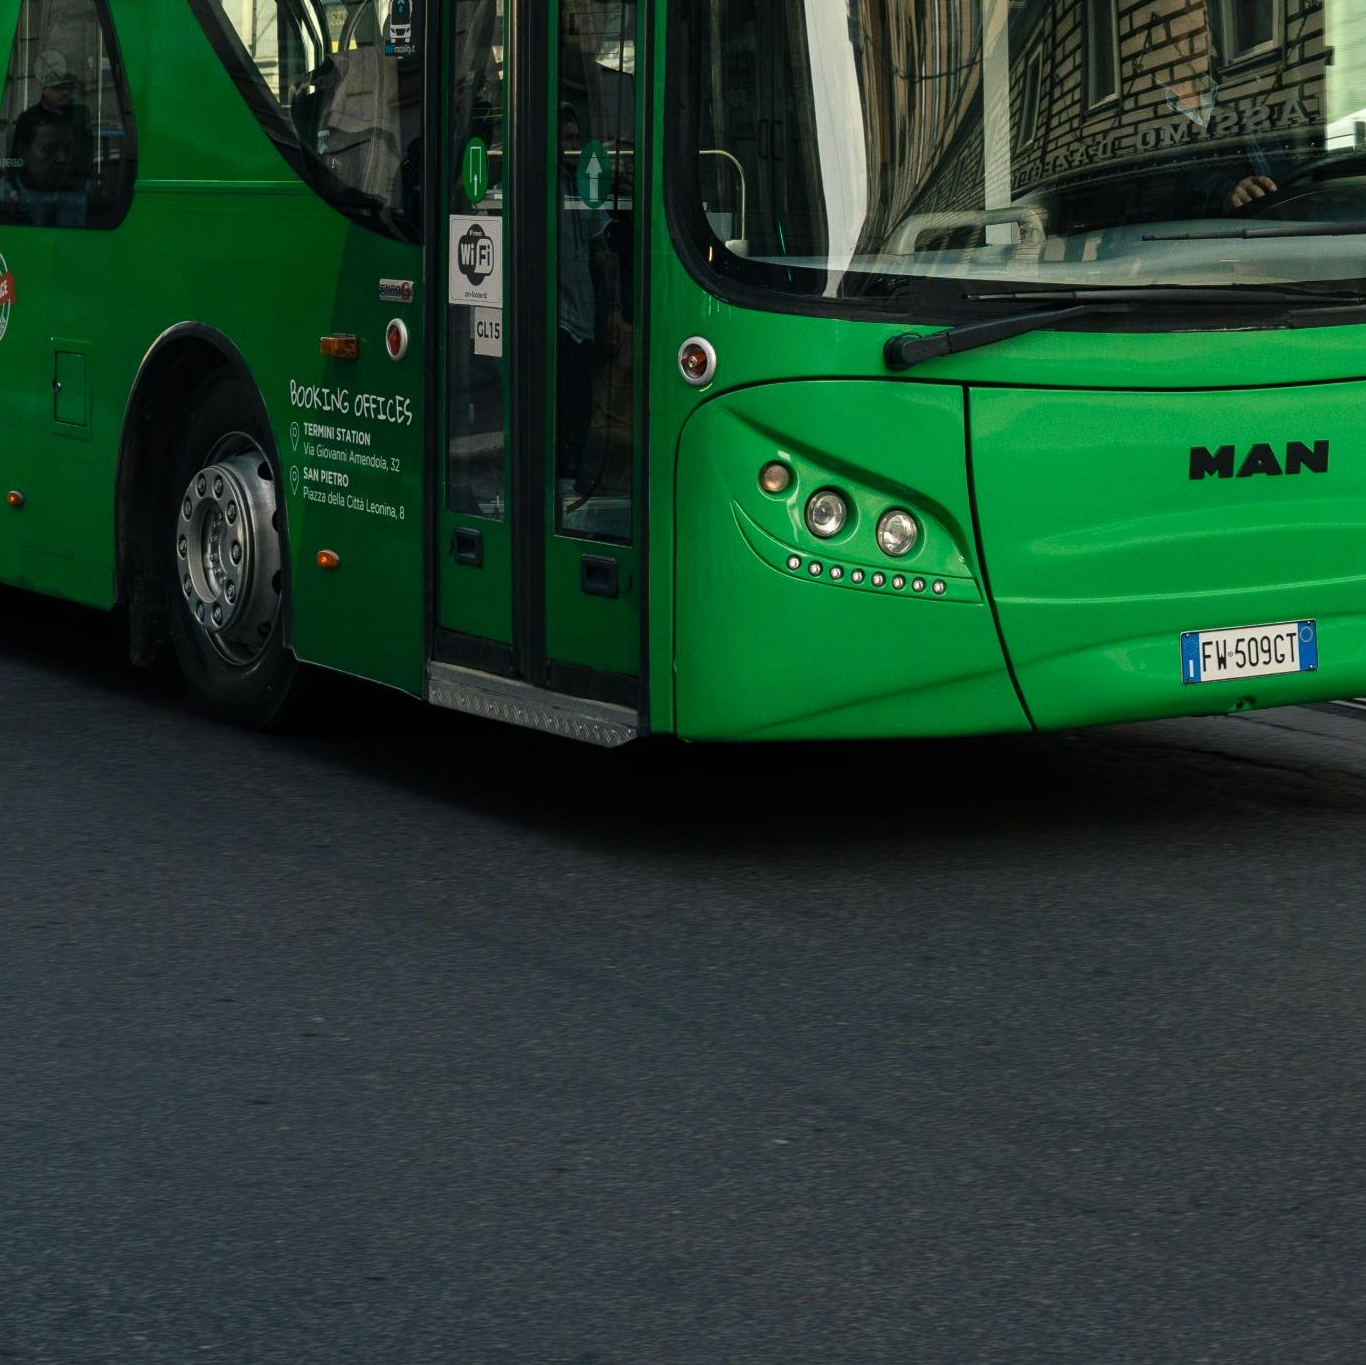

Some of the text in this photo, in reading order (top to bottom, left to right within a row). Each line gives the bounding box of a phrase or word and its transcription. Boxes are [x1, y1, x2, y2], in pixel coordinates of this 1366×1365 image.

[476, 321, 501, 340] GL15
[289, 379, 413, 426] BOOKING OFFICES
[303, 422, 371, 447] TERMINI STATION
[303, 442, 401, 473] Via Giovanni Amendola, 32
[1188, 439, 1330, 481] MAN
[303, 467, 349, 488] SAN PIETRO
[303, 486, 405, 520] Piazza della Città Leonina, 8
